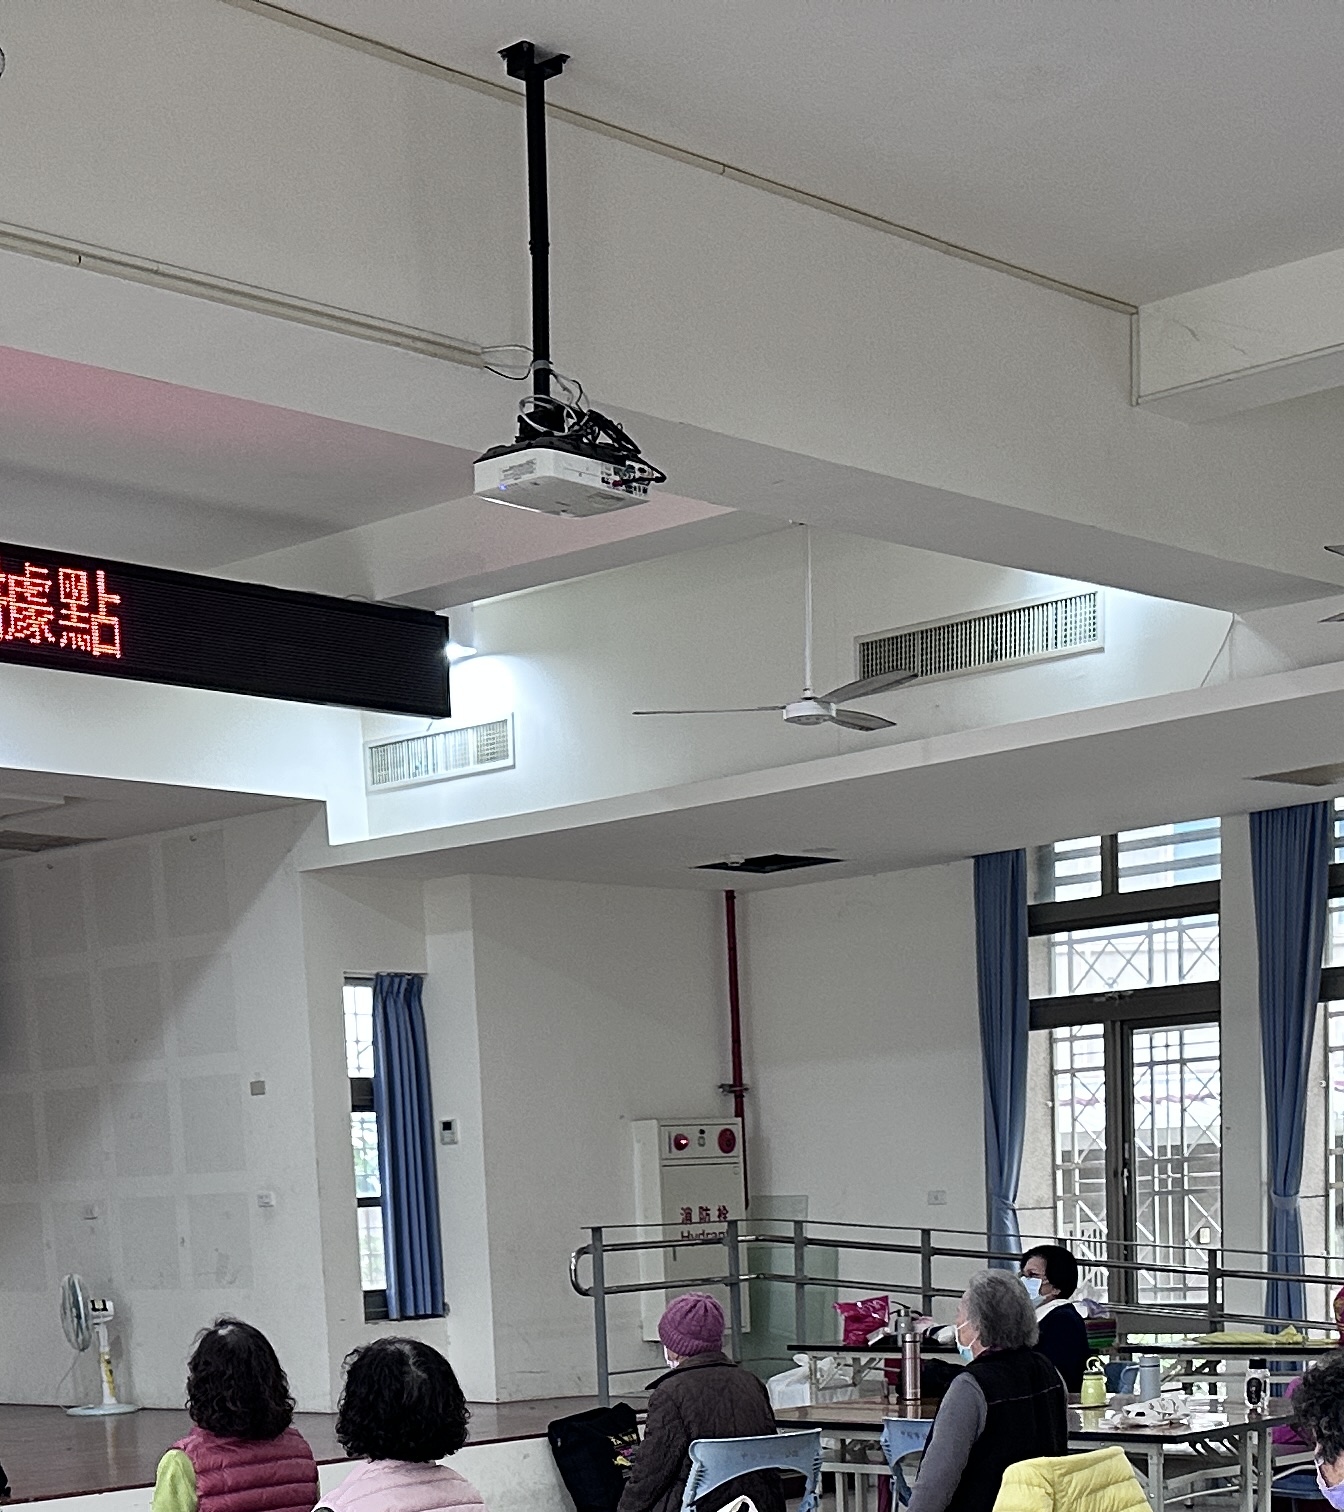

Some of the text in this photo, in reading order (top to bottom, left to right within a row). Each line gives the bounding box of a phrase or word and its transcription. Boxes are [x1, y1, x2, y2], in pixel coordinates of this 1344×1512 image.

[680, 1205, 729, 1223] 消防栓
[680, 1230, 729, 1241] Hydran
